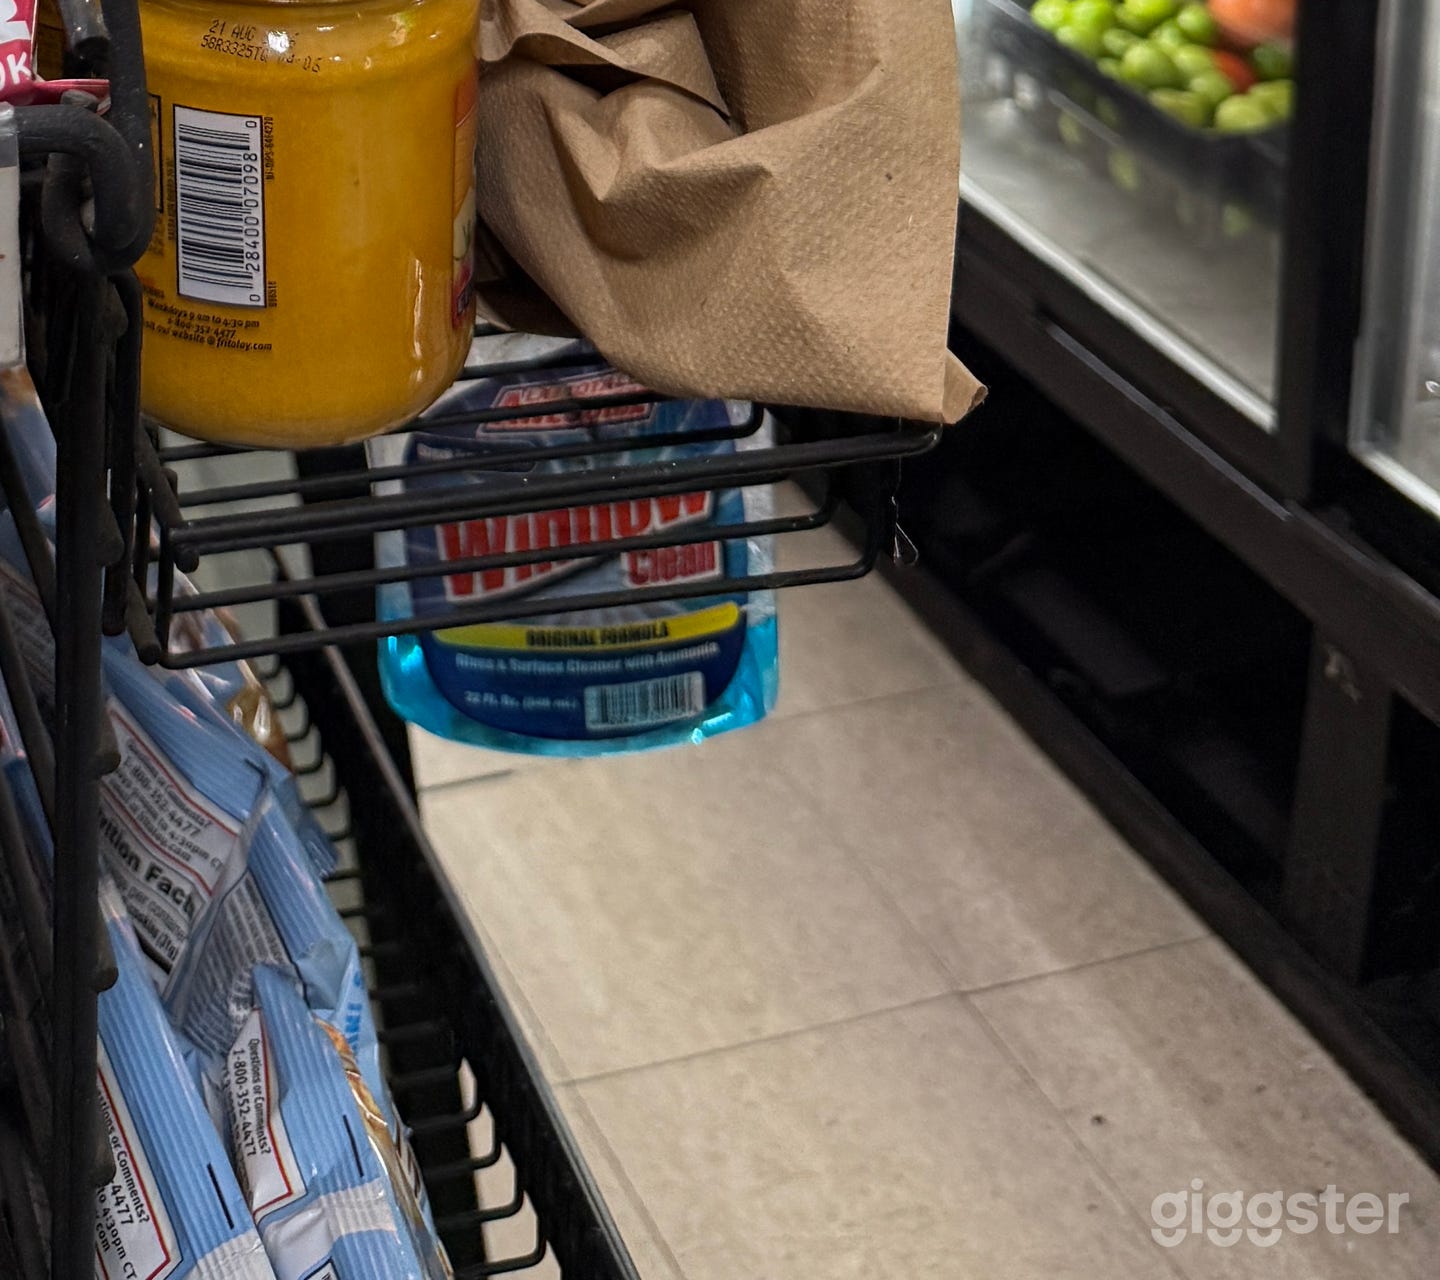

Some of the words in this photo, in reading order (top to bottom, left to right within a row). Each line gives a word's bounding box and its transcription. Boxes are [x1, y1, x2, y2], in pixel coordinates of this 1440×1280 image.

[242, 151, 259, 209] 07098
[243, 215, 261, 274] 28400
[116, 1148, 151, 1224] Comments?
